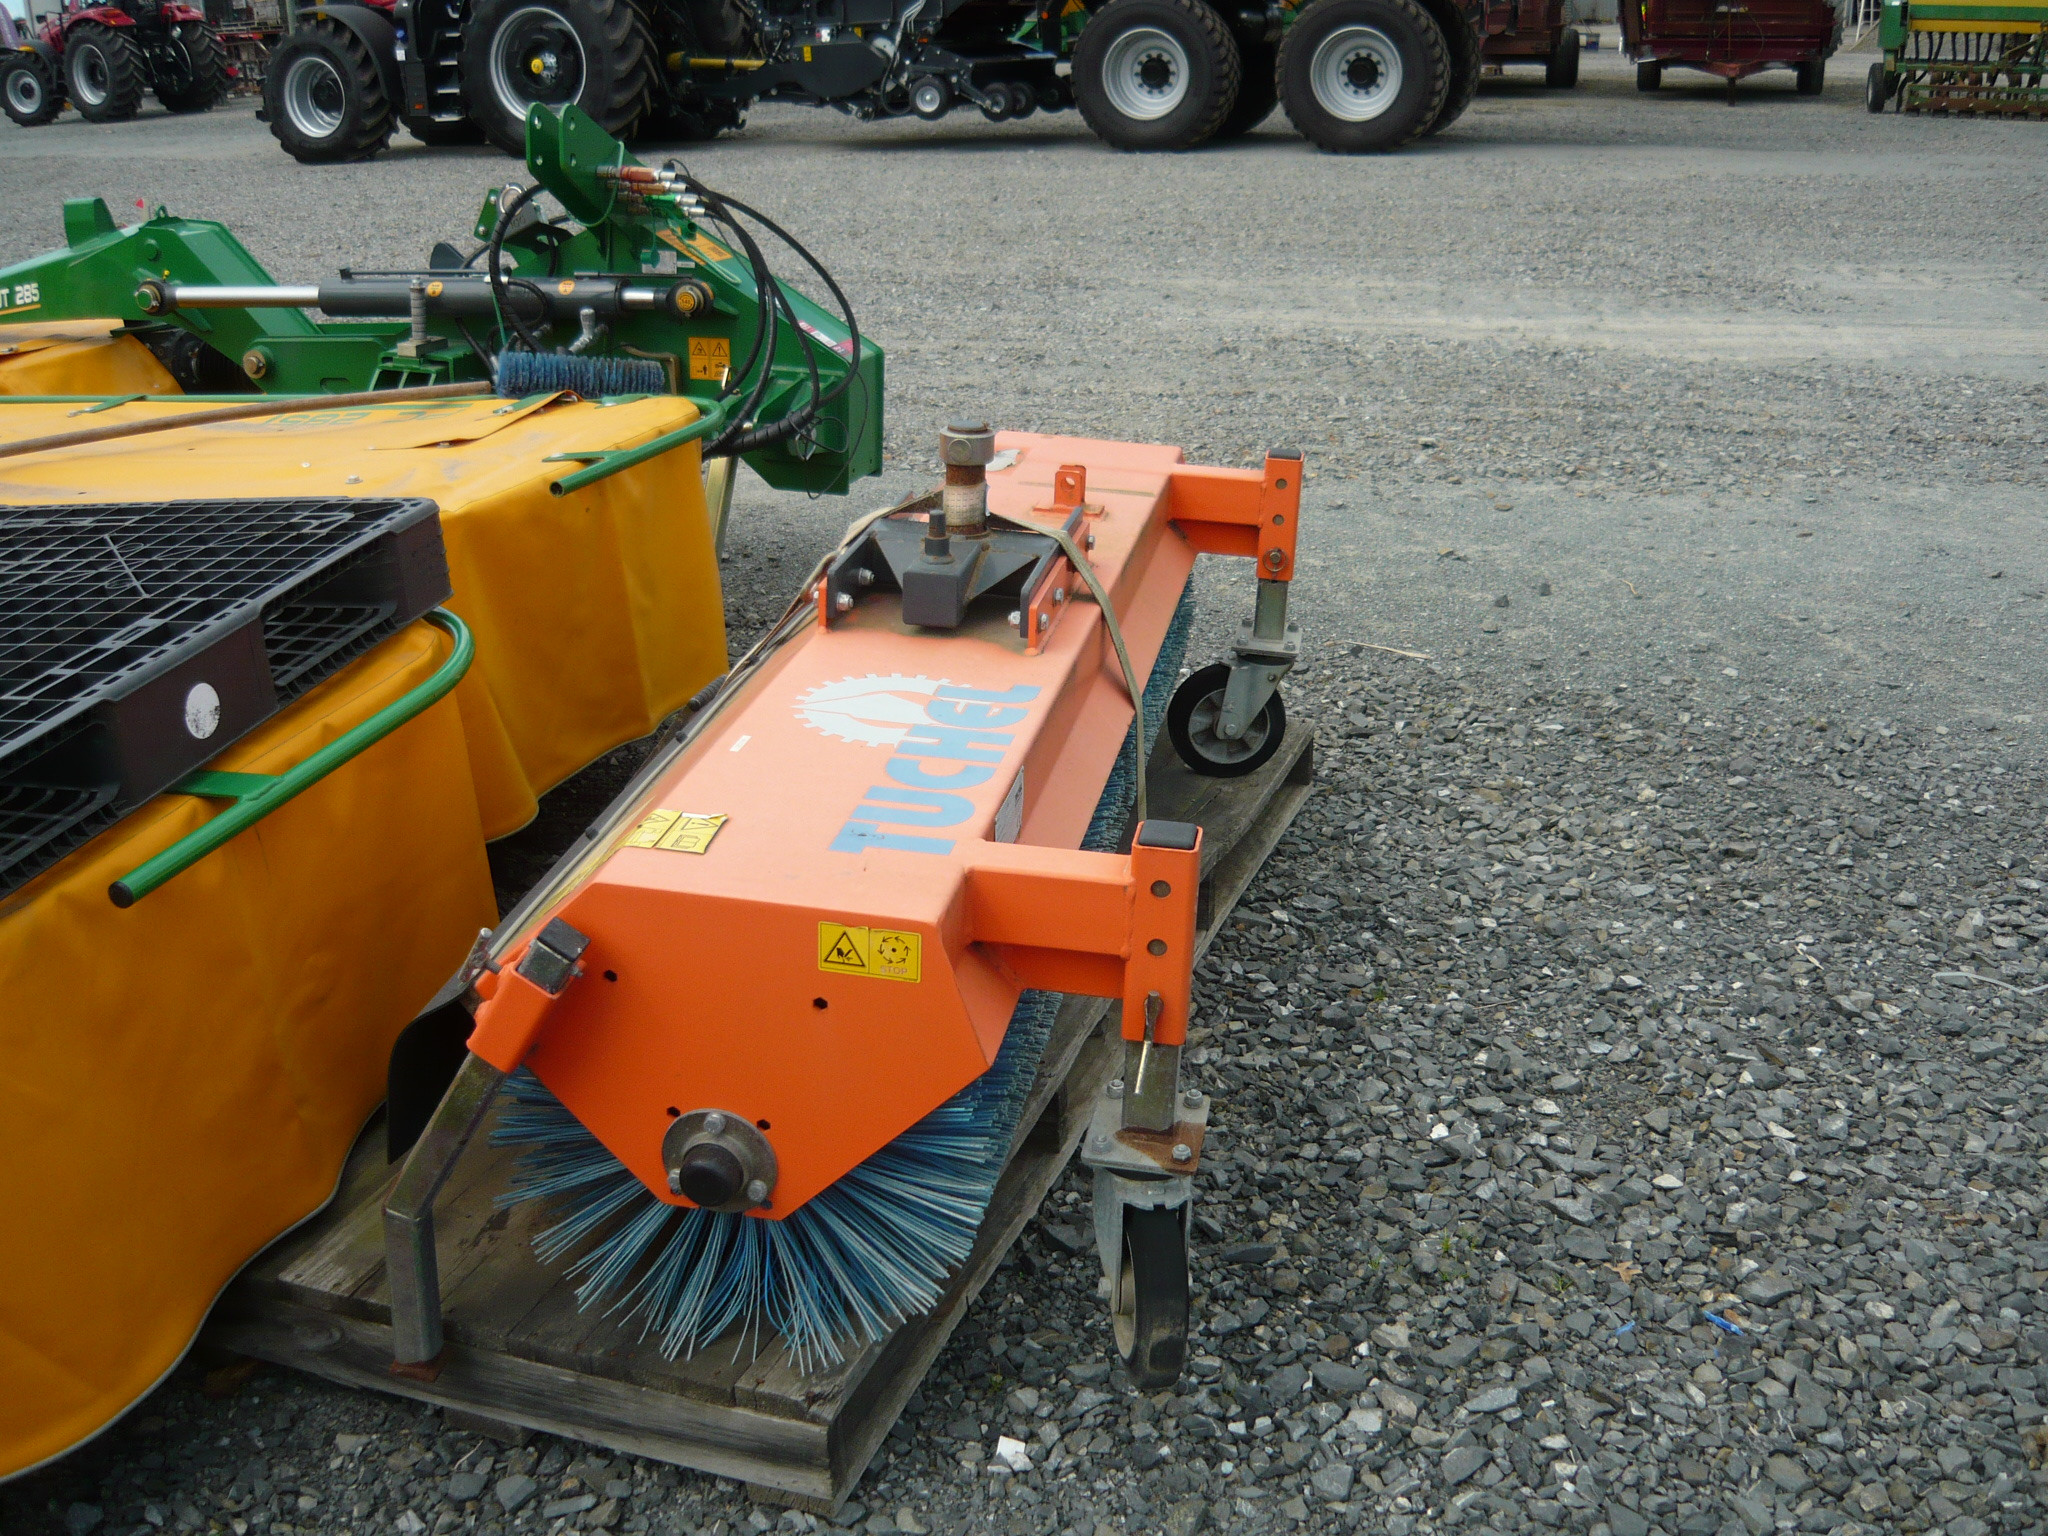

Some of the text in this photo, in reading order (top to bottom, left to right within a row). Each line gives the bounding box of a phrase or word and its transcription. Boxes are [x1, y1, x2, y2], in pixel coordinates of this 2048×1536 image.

[15, 283, 40, 305] 285
[827, 684, 1043, 856] TUCHEL
[880, 965, 908, 975] STOP
